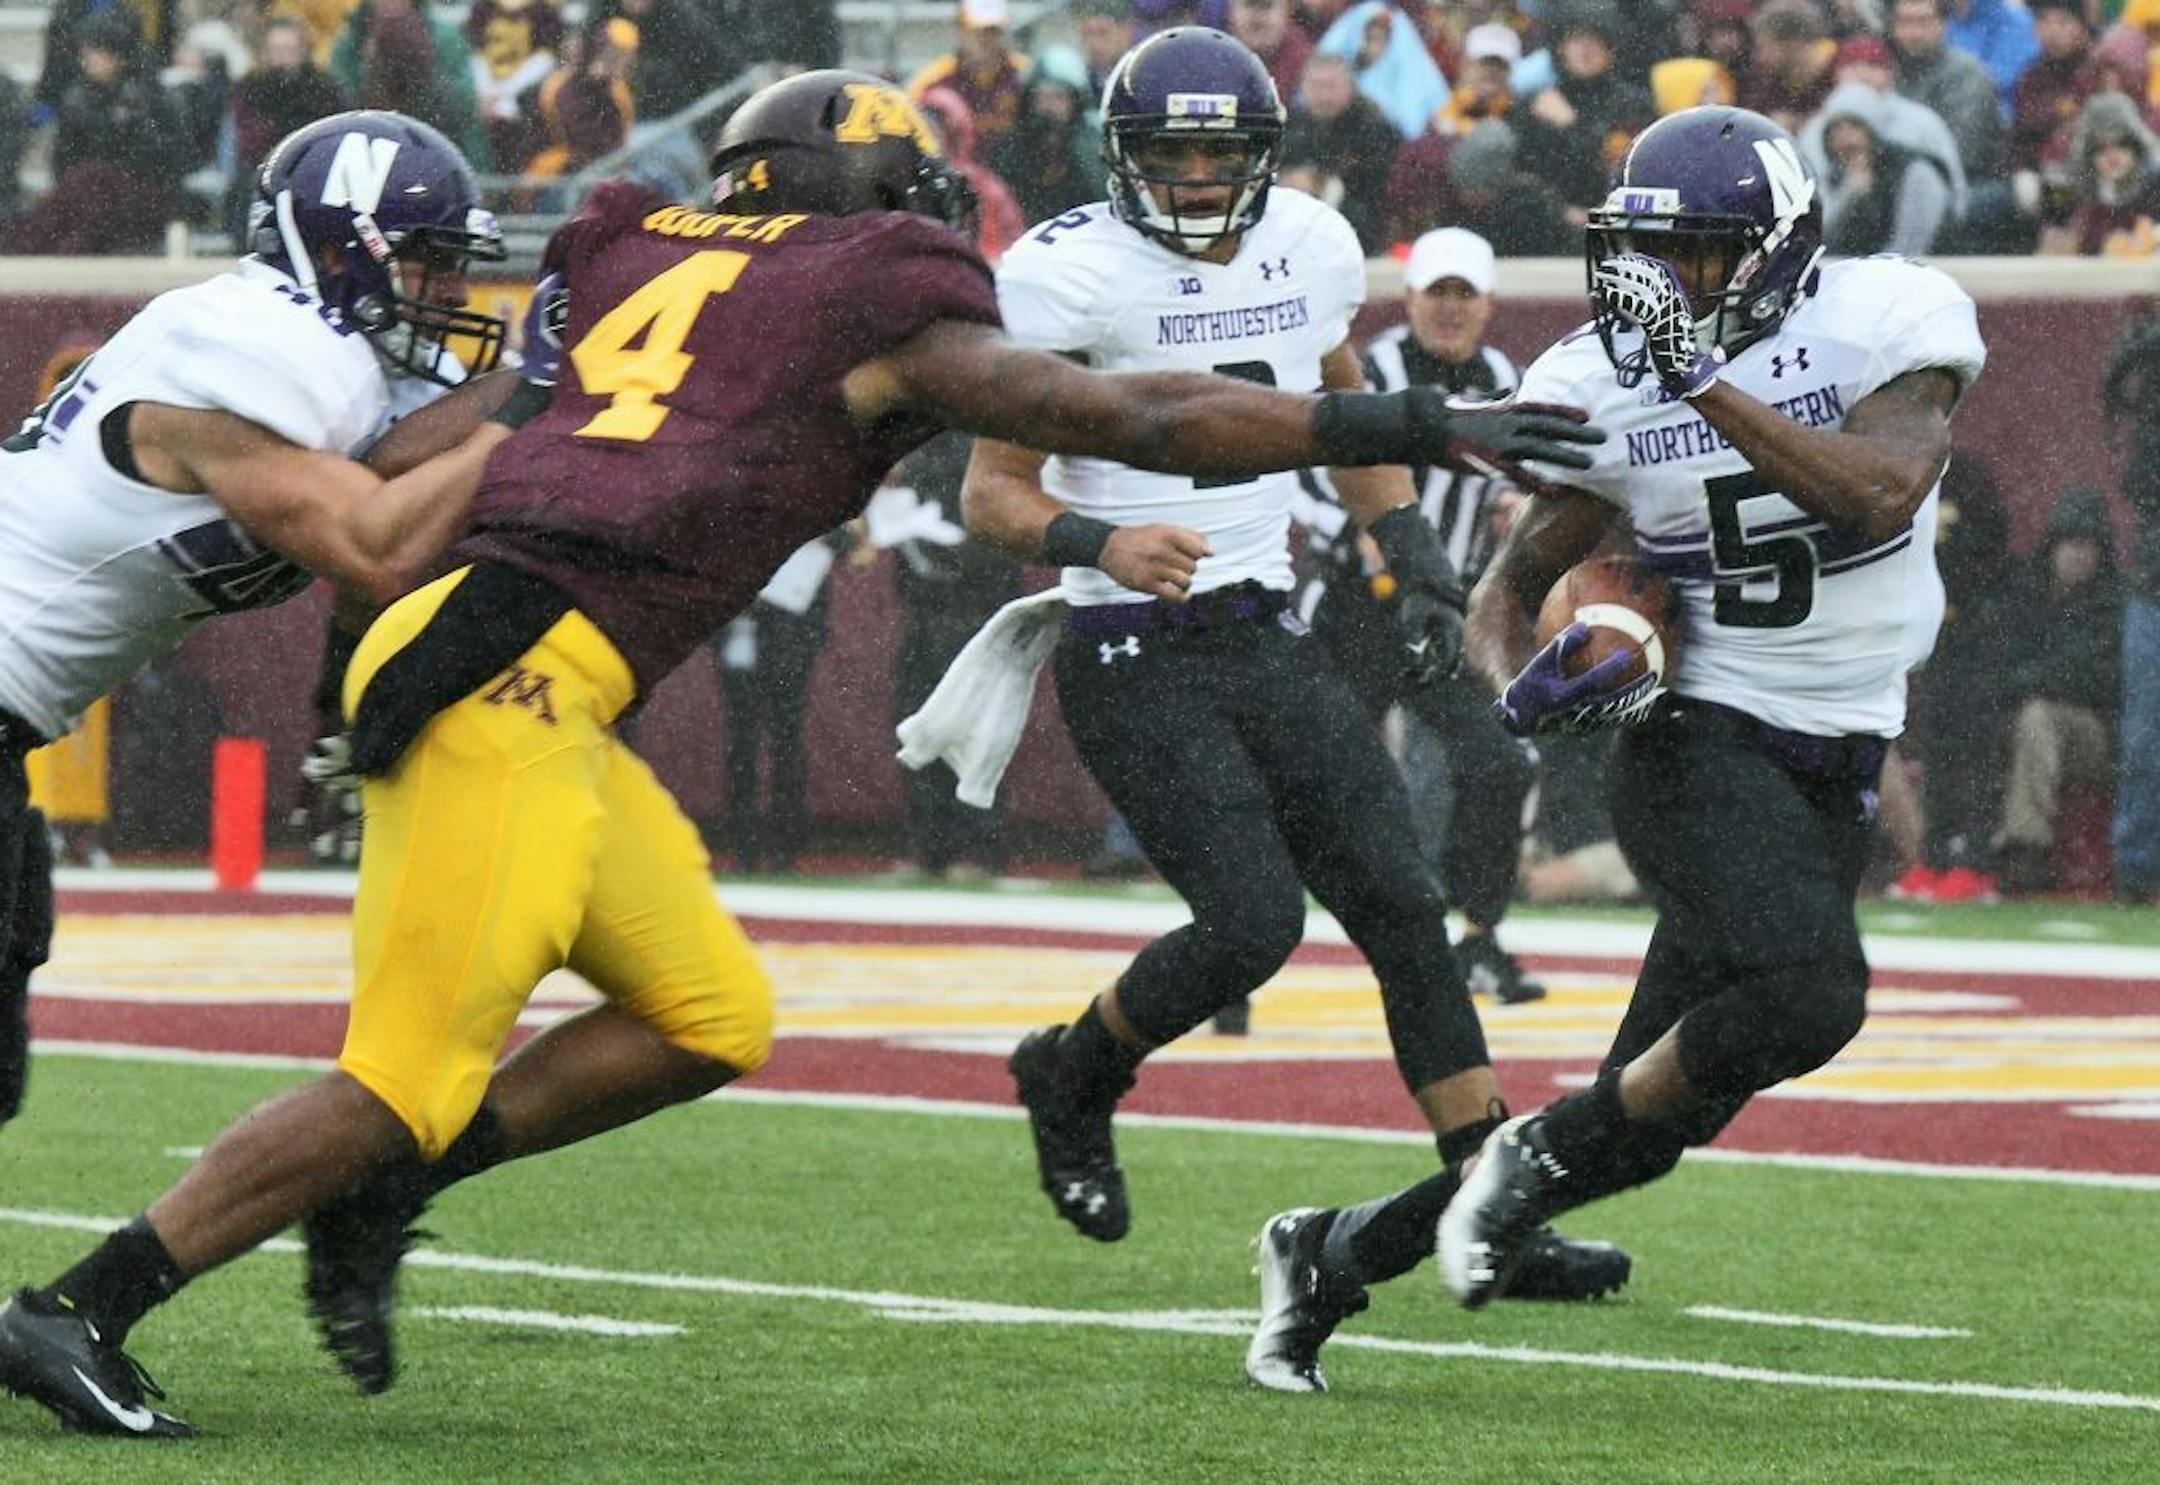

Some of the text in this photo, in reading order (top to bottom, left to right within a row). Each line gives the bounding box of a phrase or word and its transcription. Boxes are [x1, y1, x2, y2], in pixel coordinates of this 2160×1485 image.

[835, 84, 942, 160] M
[320, 132, 401, 216] N
[1752, 137, 1812, 219] N
[570, 250, 752, 441] 4
[1157, 295, 1310, 345] NORTHWESTERN
[1703, 470, 1816, 629] 5
